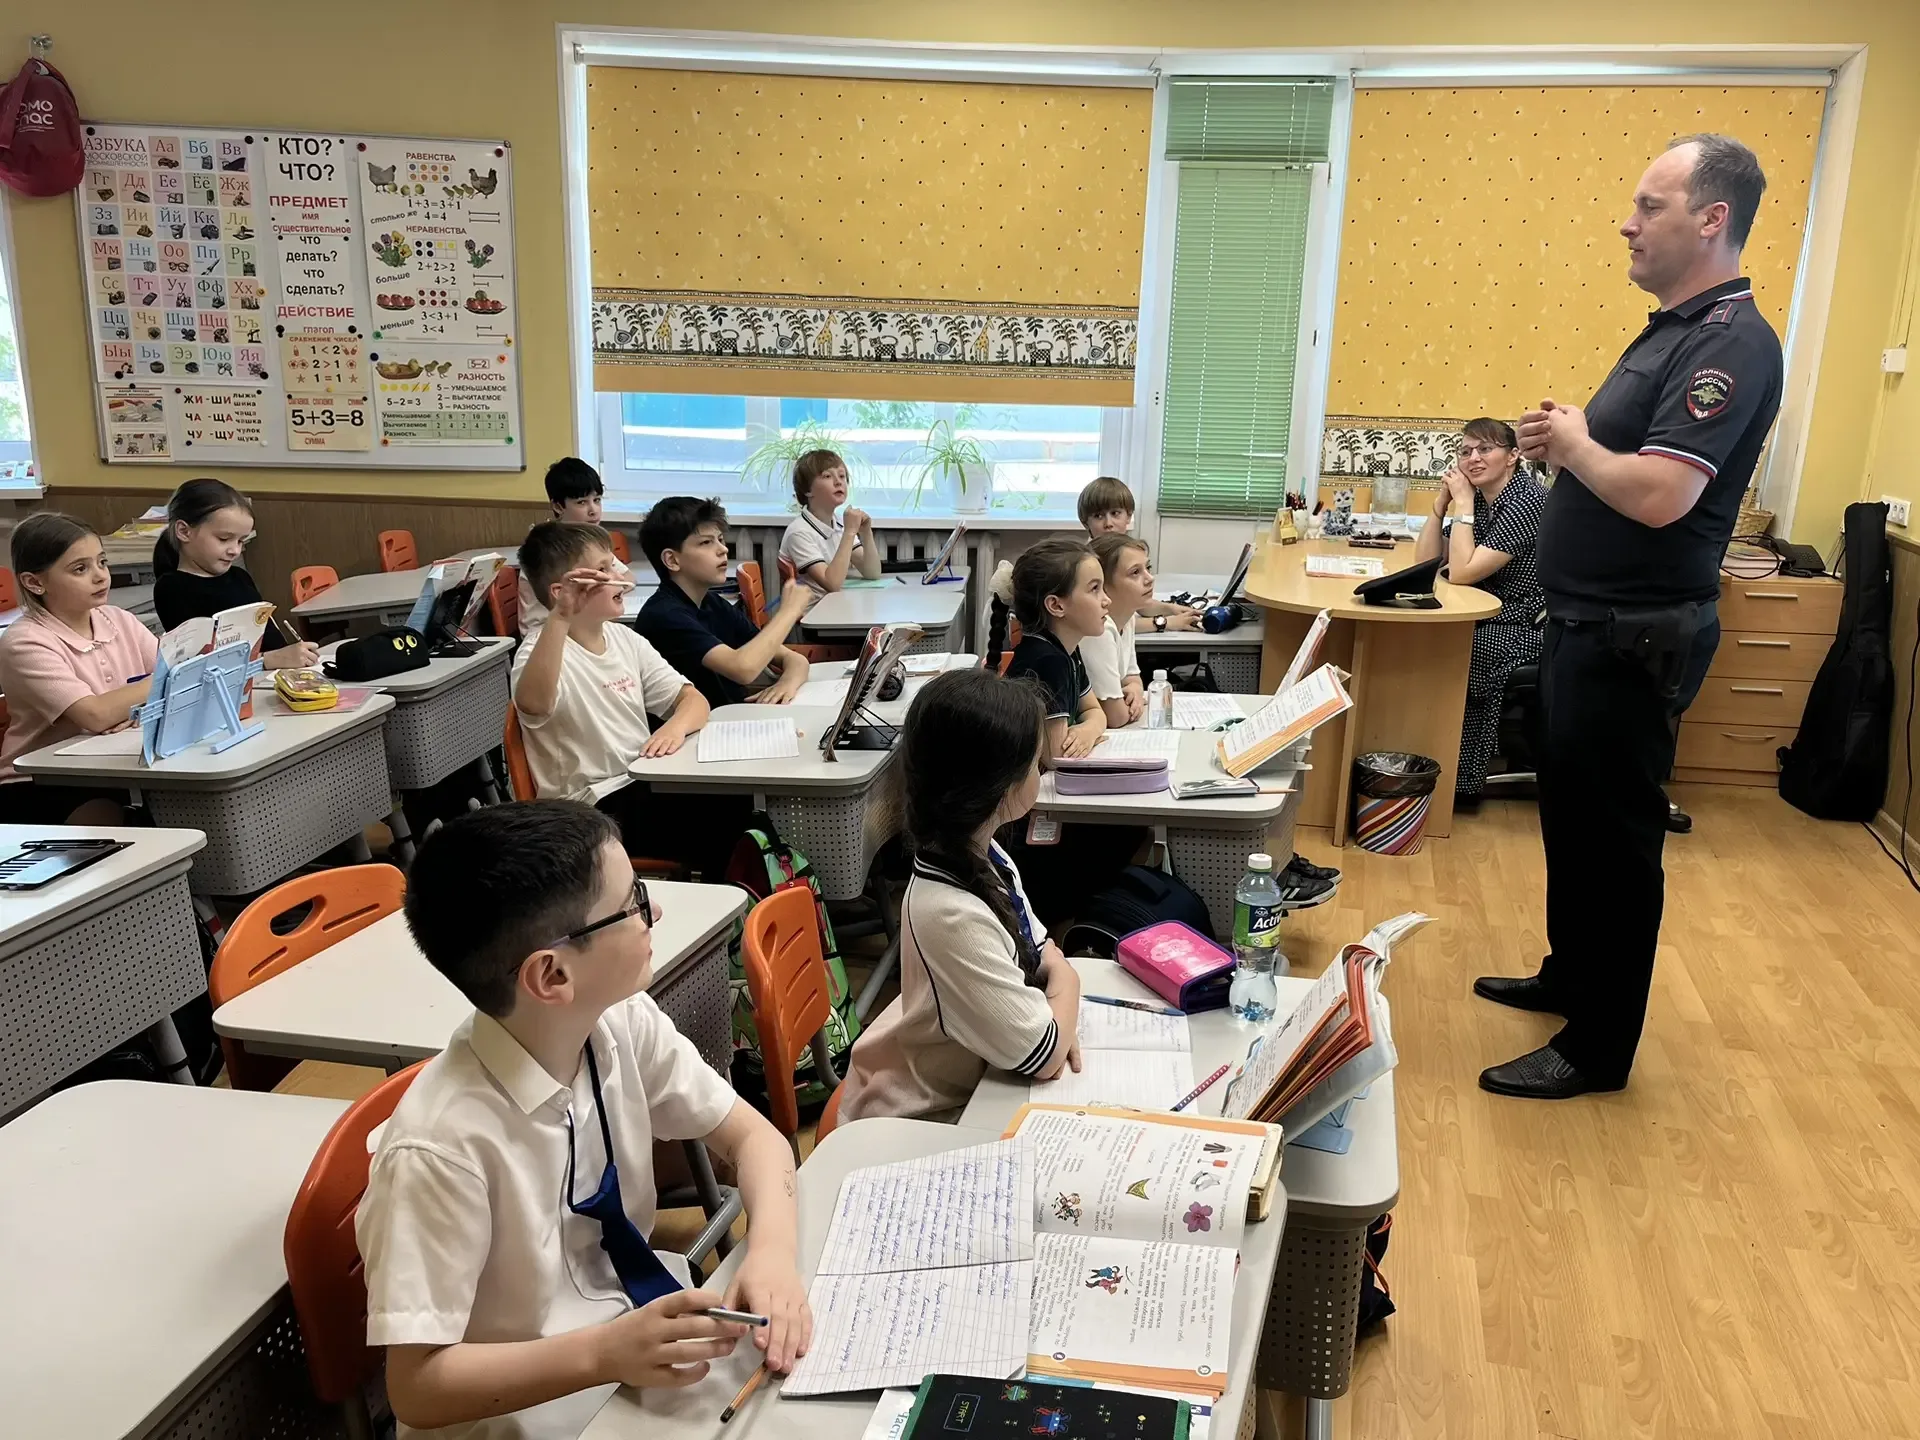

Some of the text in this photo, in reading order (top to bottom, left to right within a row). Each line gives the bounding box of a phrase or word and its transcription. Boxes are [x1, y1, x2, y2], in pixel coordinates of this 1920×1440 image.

[84, 137, 146, 152] АЗБУКА
[155, 140, 241, 156] Аа Бб Вв
[278, 137, 332, 156] КТО?
[406, 152, 456, 162] РАВЕНСТВА
[279, 163, 335, 181] ЧТО?
[93, 172, 249, 191] Гг Дд Ее Ёё Жж
[269, 195, 348, 209] ПРЕДМЕТ
[95, 207, 248, 226] Зз Ии Йй Кк Лл
[301, 213, 320, 221] имя
[370, 210, 418, 224] столько же
[273, 224, 351, 235] существительное
[406, 225, 467, 235] НЕРАВЕНСТВА
[300, 236, 321, 245] что
[94, 242, 250, 263] Мм Нн Оо Пп Рр
[286, 250, 338, 263] делать?
[303, 269, 325, 278] что
[375, 272, 410, 284] больше
[102, 276, 253, 295] Сс Тт Уу Фф Хх
[286, 284, 345, 296] сделать?
[277, 304, 355, 318] ДЕЙСТВИЕ
[103, 311, 259, 328] Цц Чч Шш Щщ Ъъ
[380, 318, 415, 331] меньше
[104, 344, 260, 362] Ыы Ьь Ээ Юю Яя
[457, 373, 506, 381] РАЗНОСТЬ
[1694, 377, 1728, 392] РОССИЯ
[956, 1400, 970, 1425] START
